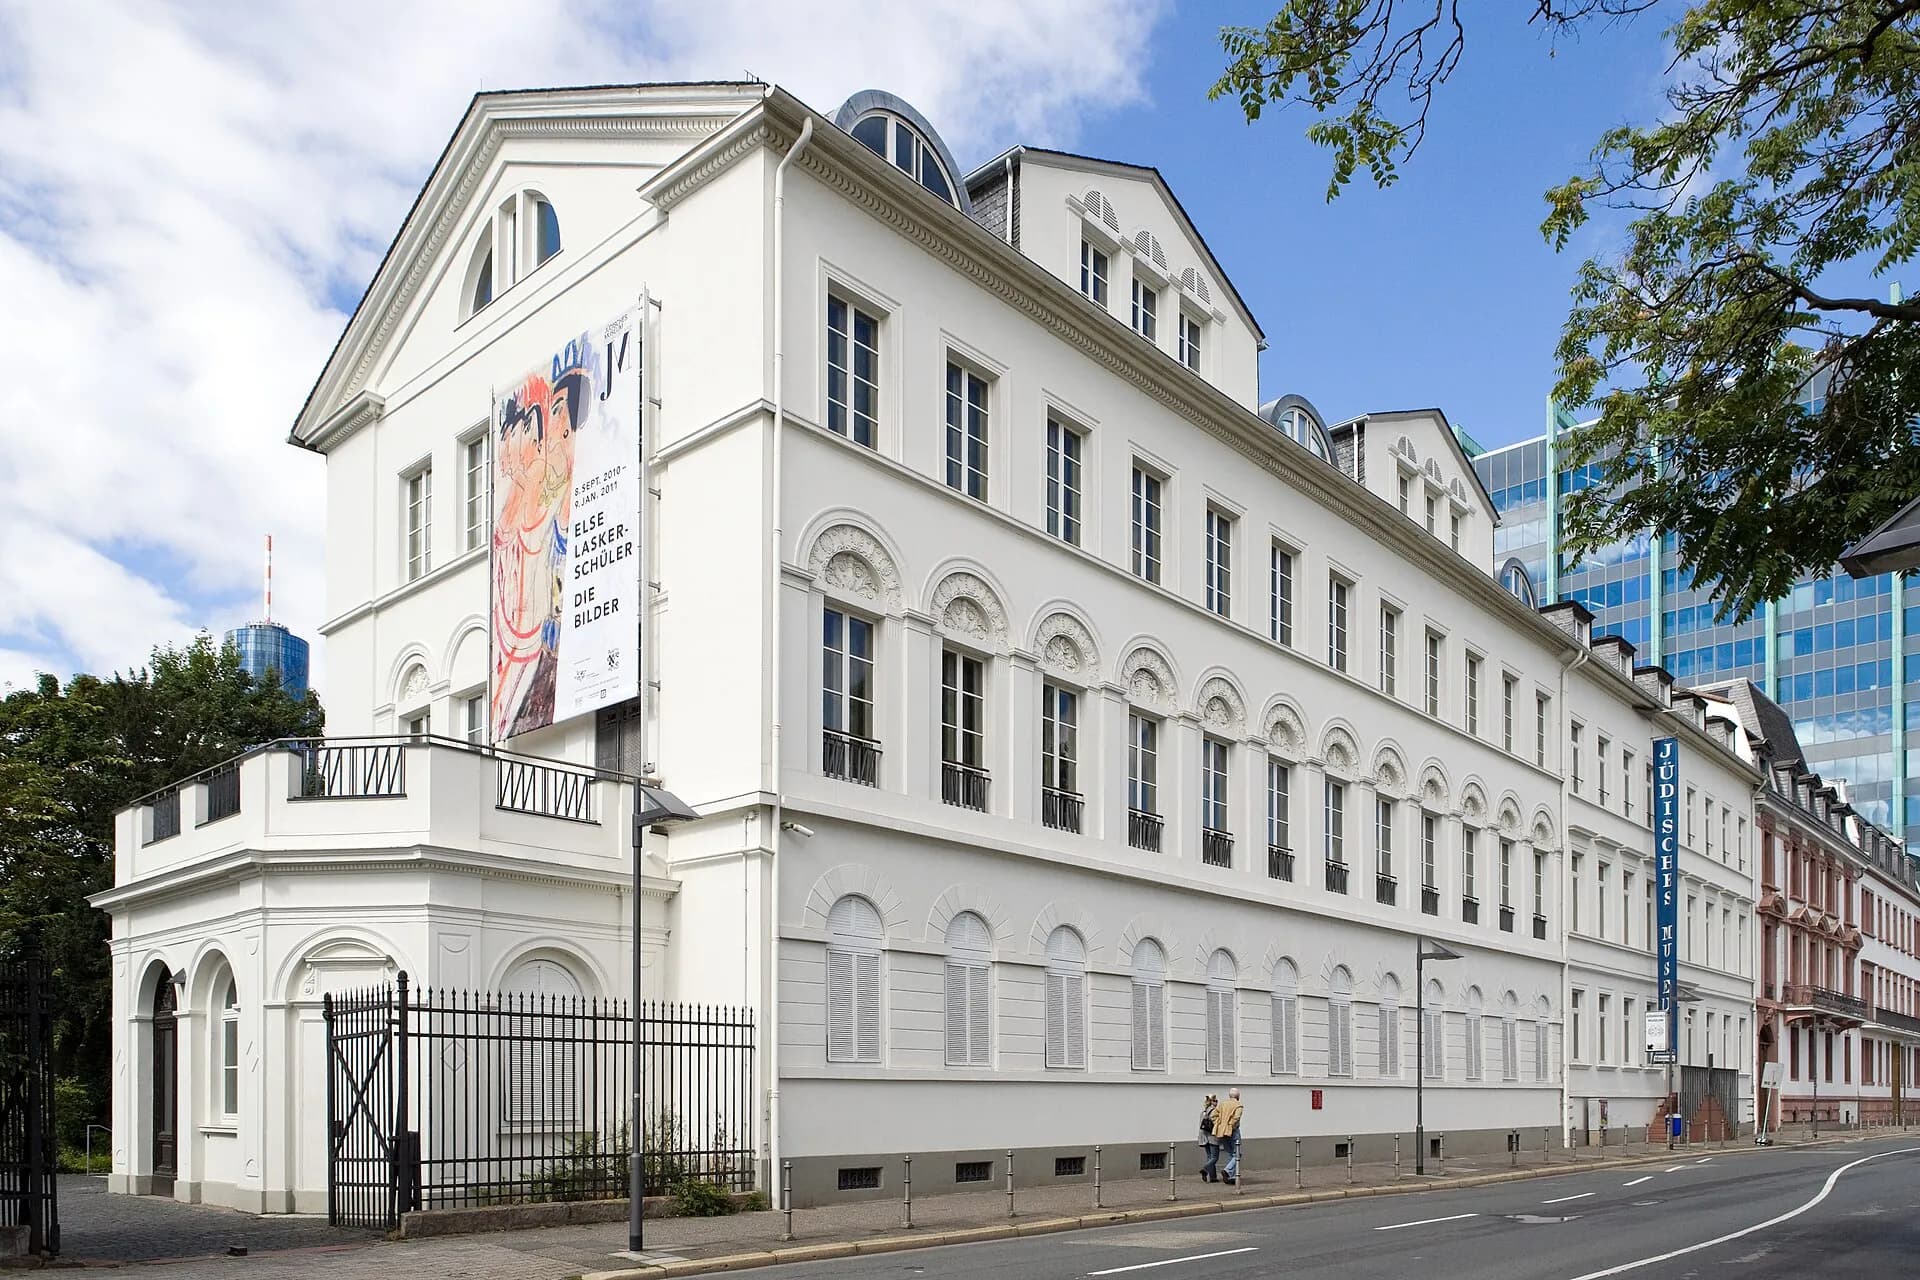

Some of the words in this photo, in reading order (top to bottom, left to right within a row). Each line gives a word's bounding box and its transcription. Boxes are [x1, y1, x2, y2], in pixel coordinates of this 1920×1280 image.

[600, 480, 618, 496] 2011
[574, 511, 604, 538] ELSE
[574, 523, 629, 559] LASKER-
[574, 541, 632, 580] SCHÜLER
[574, 586, 595, 608] DIE
[574, 597, 619, 629] BILDER
[1658, 742, 1675, 906] JÜDISCHES
[1661, 924, 1673, 1012] MUSEU
